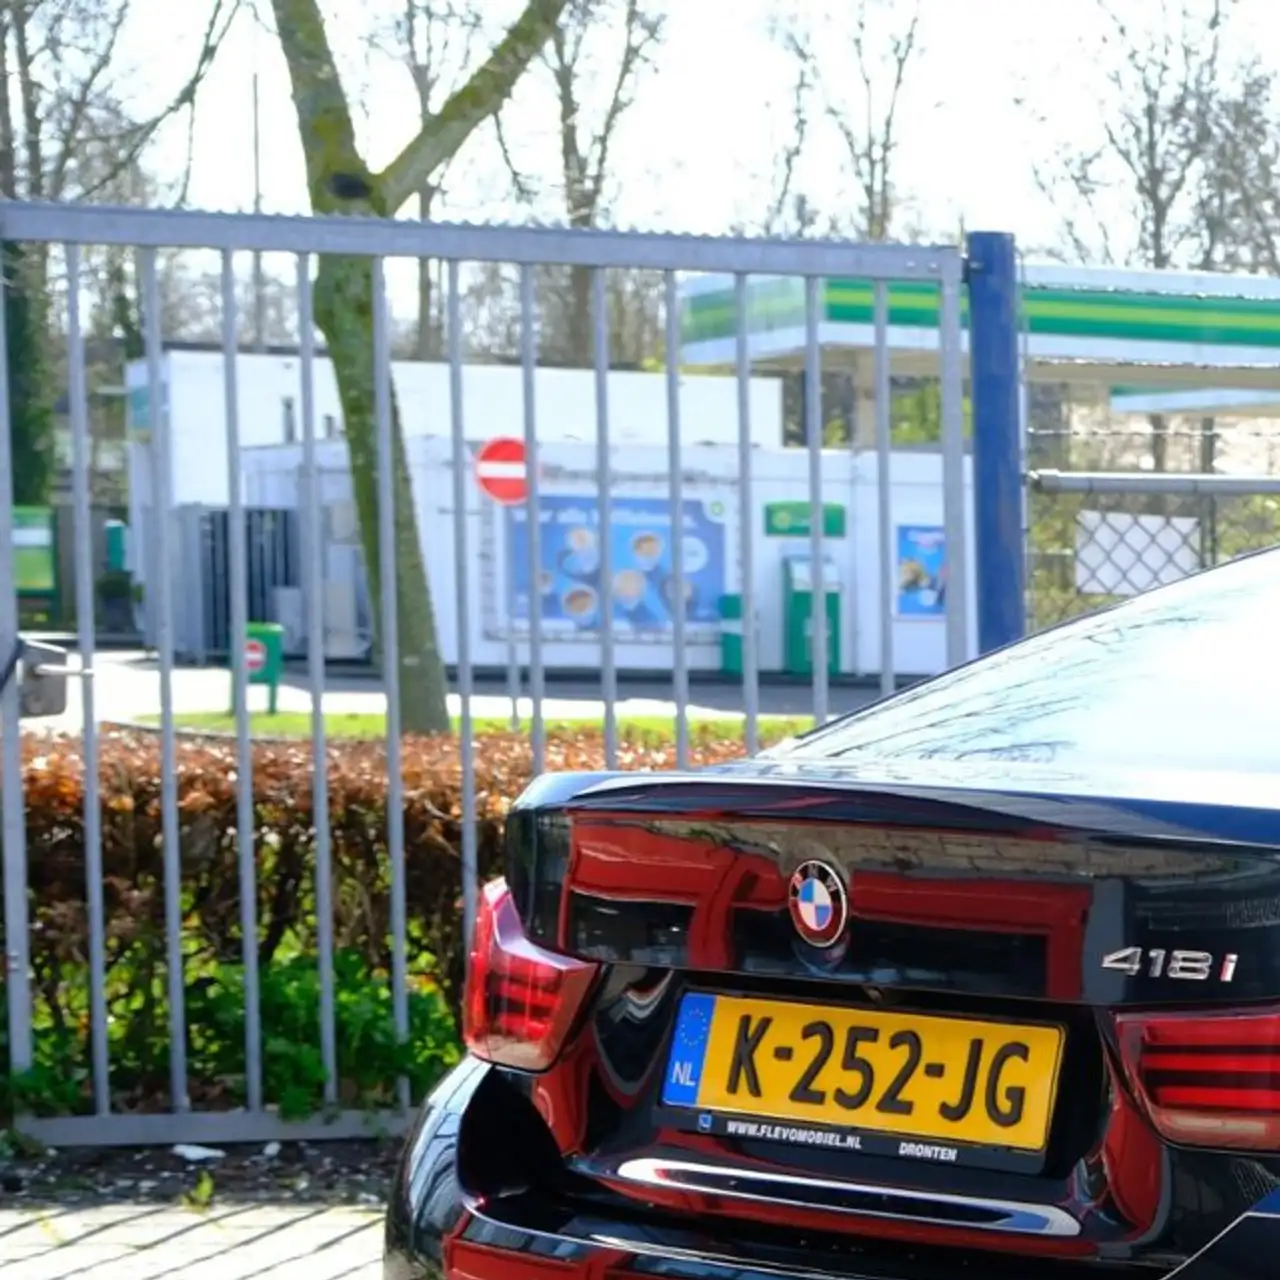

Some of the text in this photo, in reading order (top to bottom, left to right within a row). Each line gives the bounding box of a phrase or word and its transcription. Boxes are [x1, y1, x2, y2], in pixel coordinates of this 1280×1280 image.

[1101, 946, 1239, 983] 418i
[671, 1061, 696, 1087] NL
[726, 1013, 1031, 1128] K-252-JG
[726, 1120, 959, 1162] WWW.FLEVOMOBIEL.NL DRONTEN
